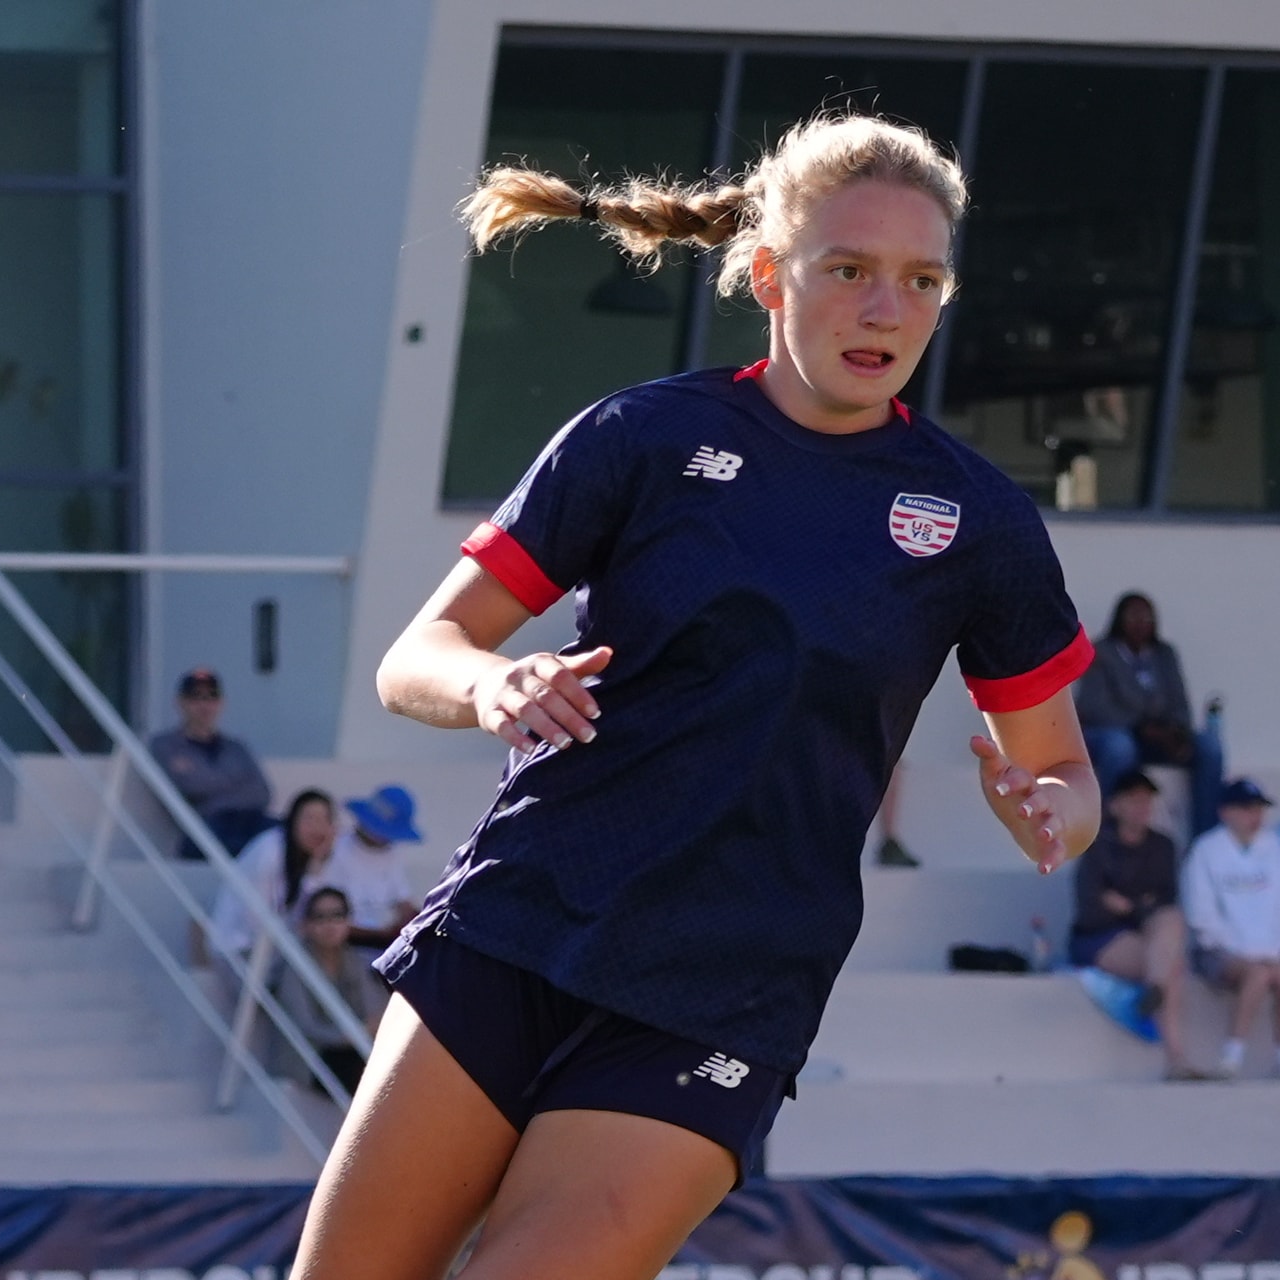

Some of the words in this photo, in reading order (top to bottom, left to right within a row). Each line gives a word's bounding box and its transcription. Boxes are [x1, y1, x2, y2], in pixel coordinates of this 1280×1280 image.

[904, 498, 952, 514] NATIONAL
[912, 520, 934, 533] US
[911, 529, 931, 542] YS
